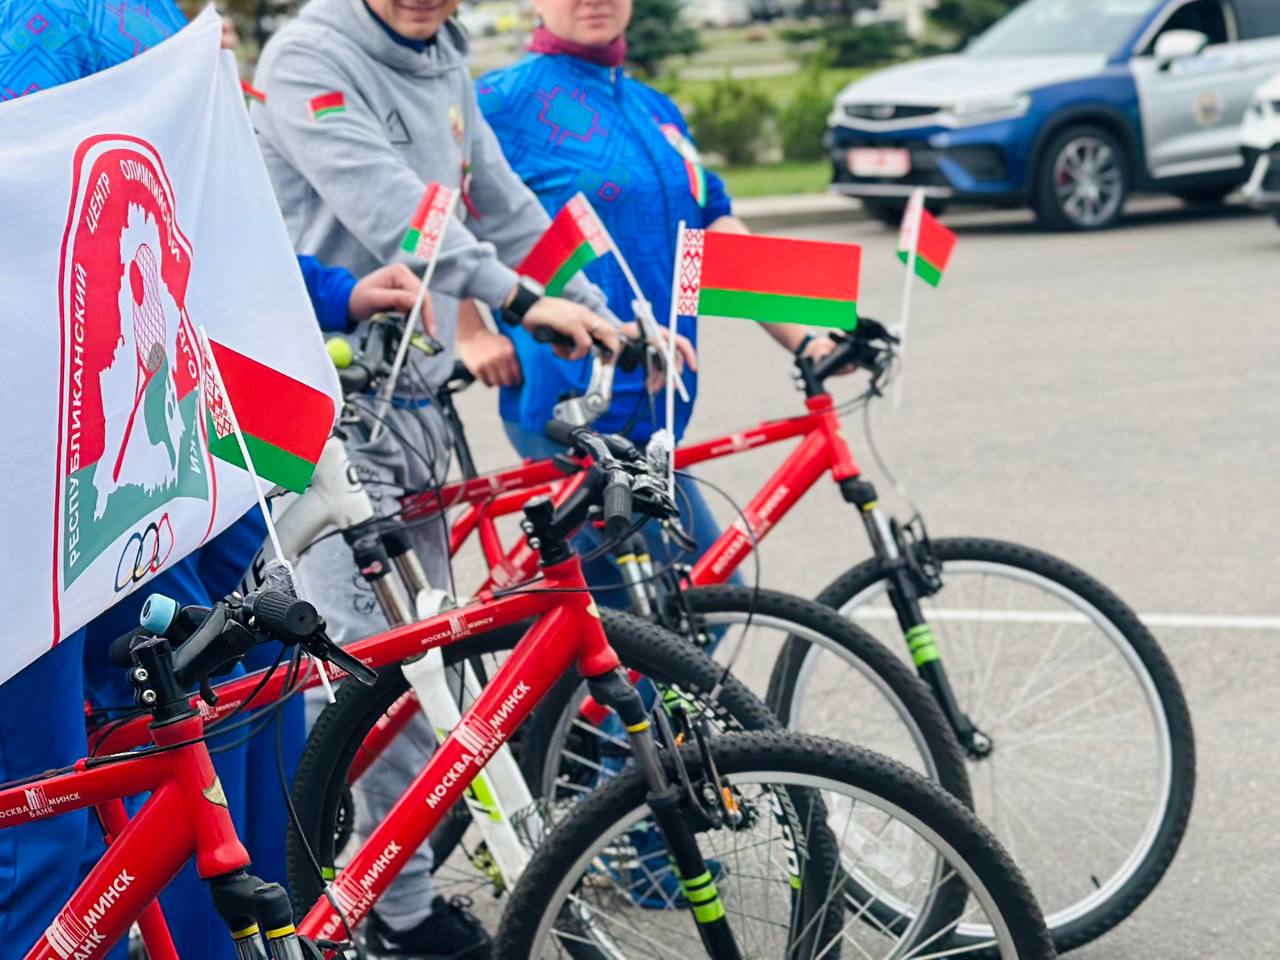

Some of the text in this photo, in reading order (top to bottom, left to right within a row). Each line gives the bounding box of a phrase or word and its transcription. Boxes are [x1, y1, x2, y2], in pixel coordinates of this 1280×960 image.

[69, 262, 87, 568] РЕСПУБЛИКАНСКИЙ
[86, 171, 111, 235] ЦЕНТР
[424, 680, 532, 809] МОСКВА МИНСК
[473, 729, 506, 767] БАНК
[29, 807, 55, 819] БАНК
[48, 792, 81, 807] МИНСК
[360, 840, 402, 891] МИНСК
[83, 869, 135, 928] МИНСК
[346, 889, 376, 927] БАНК
[73, 929, 106, 960] АНК
